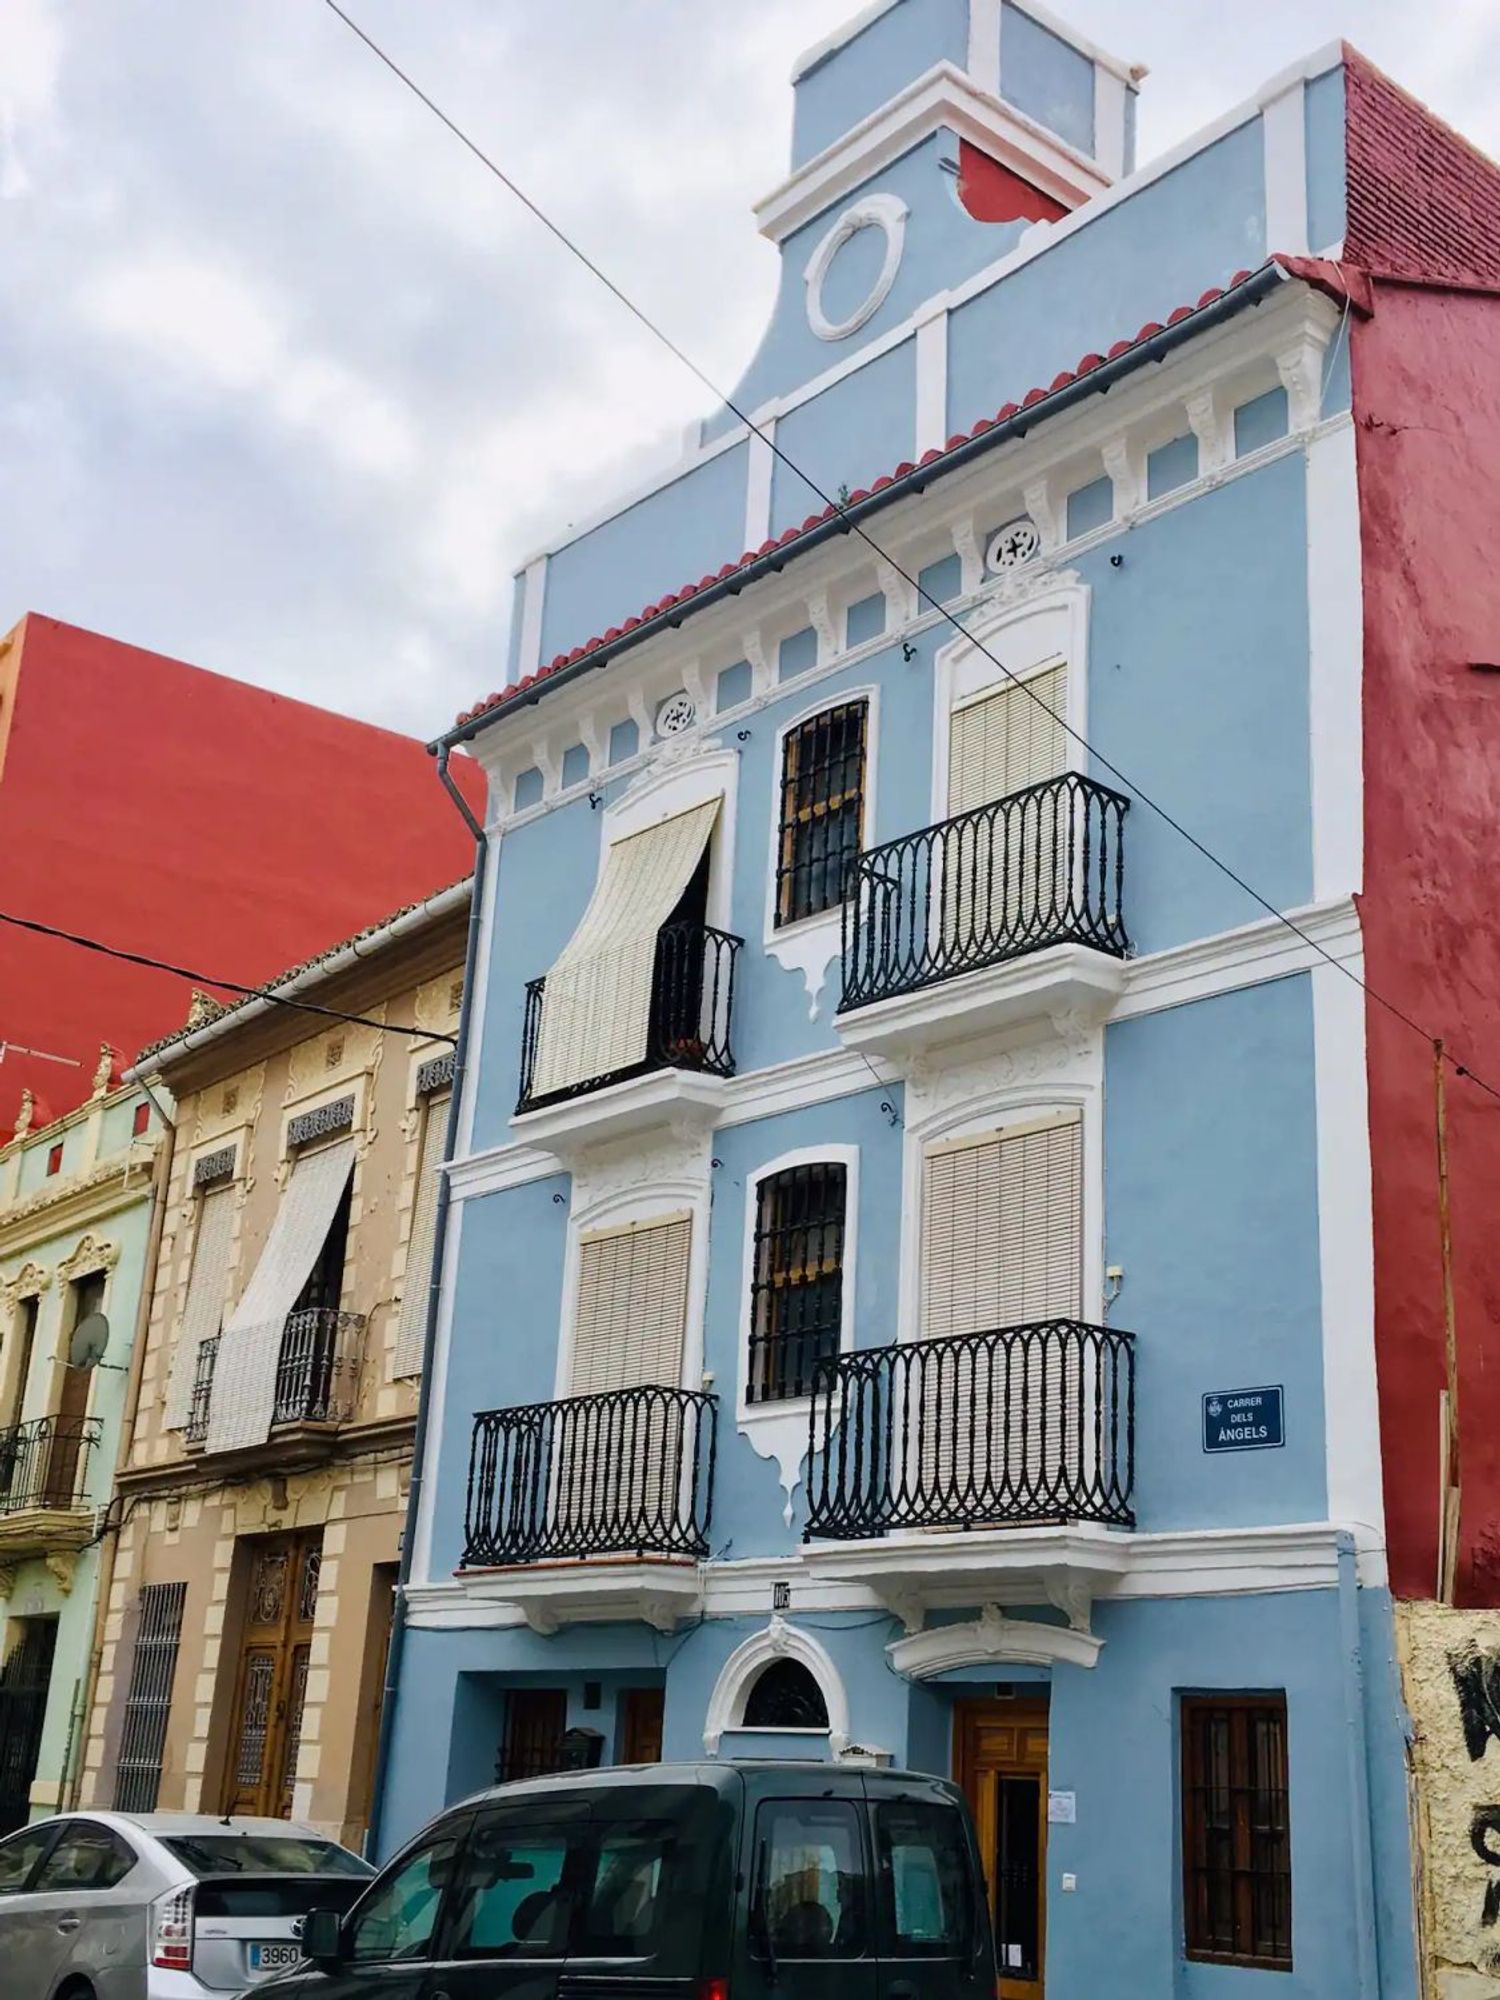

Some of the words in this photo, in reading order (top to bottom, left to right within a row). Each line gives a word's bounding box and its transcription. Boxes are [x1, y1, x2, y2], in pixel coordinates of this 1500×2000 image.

[1227, 1396, 1262, 1409] CARRER
[1230, 1412, 1253, 1423] DELS
[262, 1947, 298, 1964] 3960
